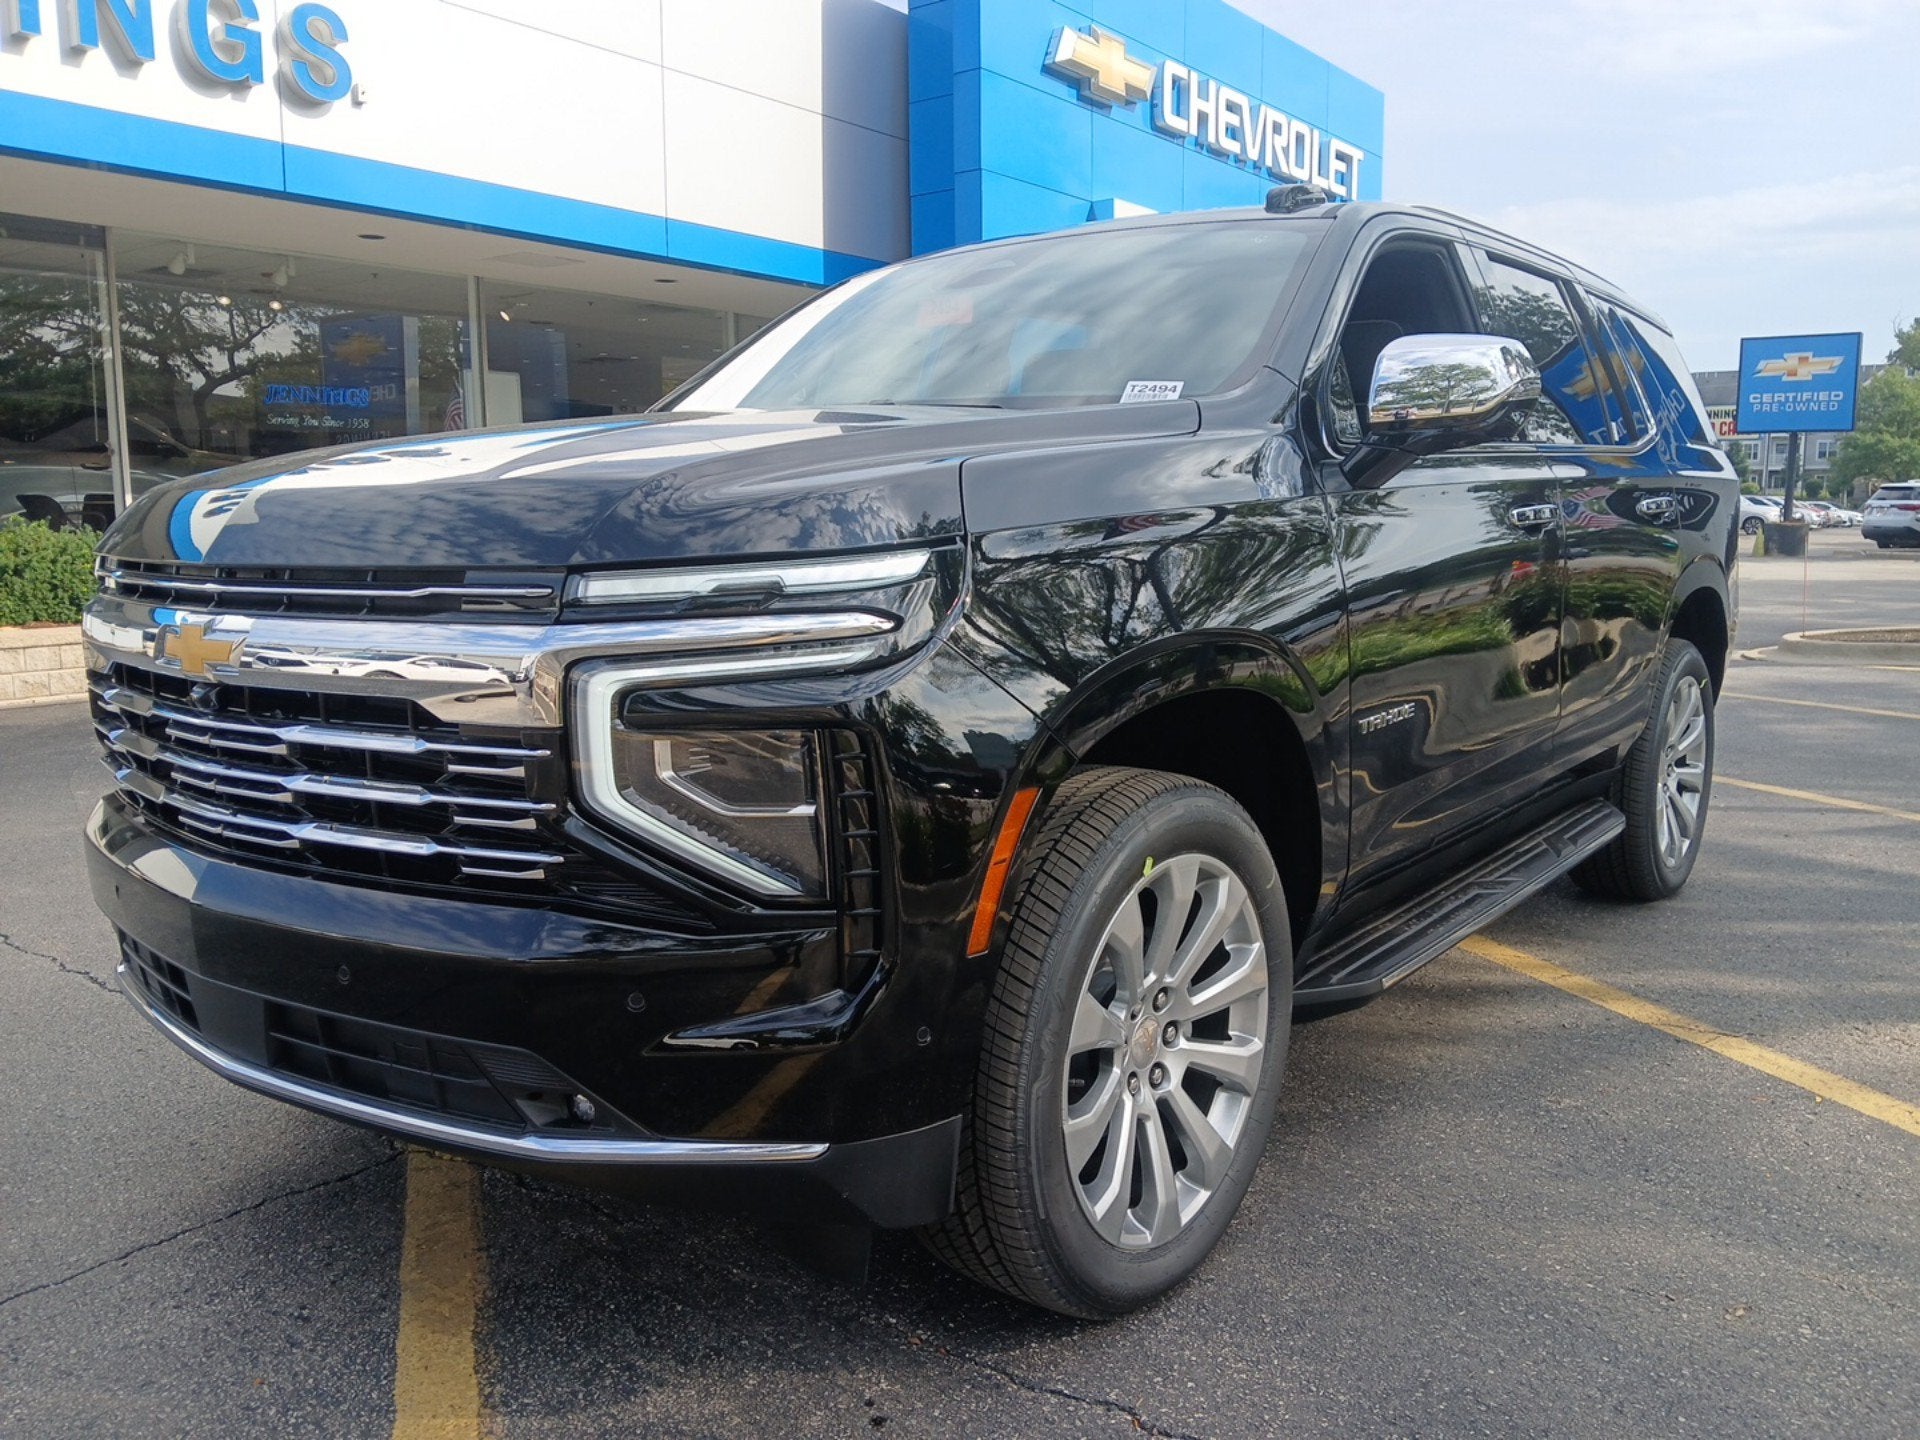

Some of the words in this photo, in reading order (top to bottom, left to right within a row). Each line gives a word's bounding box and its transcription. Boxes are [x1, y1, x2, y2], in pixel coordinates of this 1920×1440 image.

[1159, 59, 1365, 202] CHEVROLET
[264, 384, 369, 408] JENNINGS
[1129, 384, 1178, 394] T2494
[1749, 391, 1844, 404] CERTIFIED
[1752, 402, 1839, 413] PRE-OWNED
[266, 413, 300, 428] Serving
[302, 414, 320, 426] You
[321, 415, 345, 428] Since
[347, 418, 370, 429] 1958
[1358, 702, 1416, 735] TAHOE
